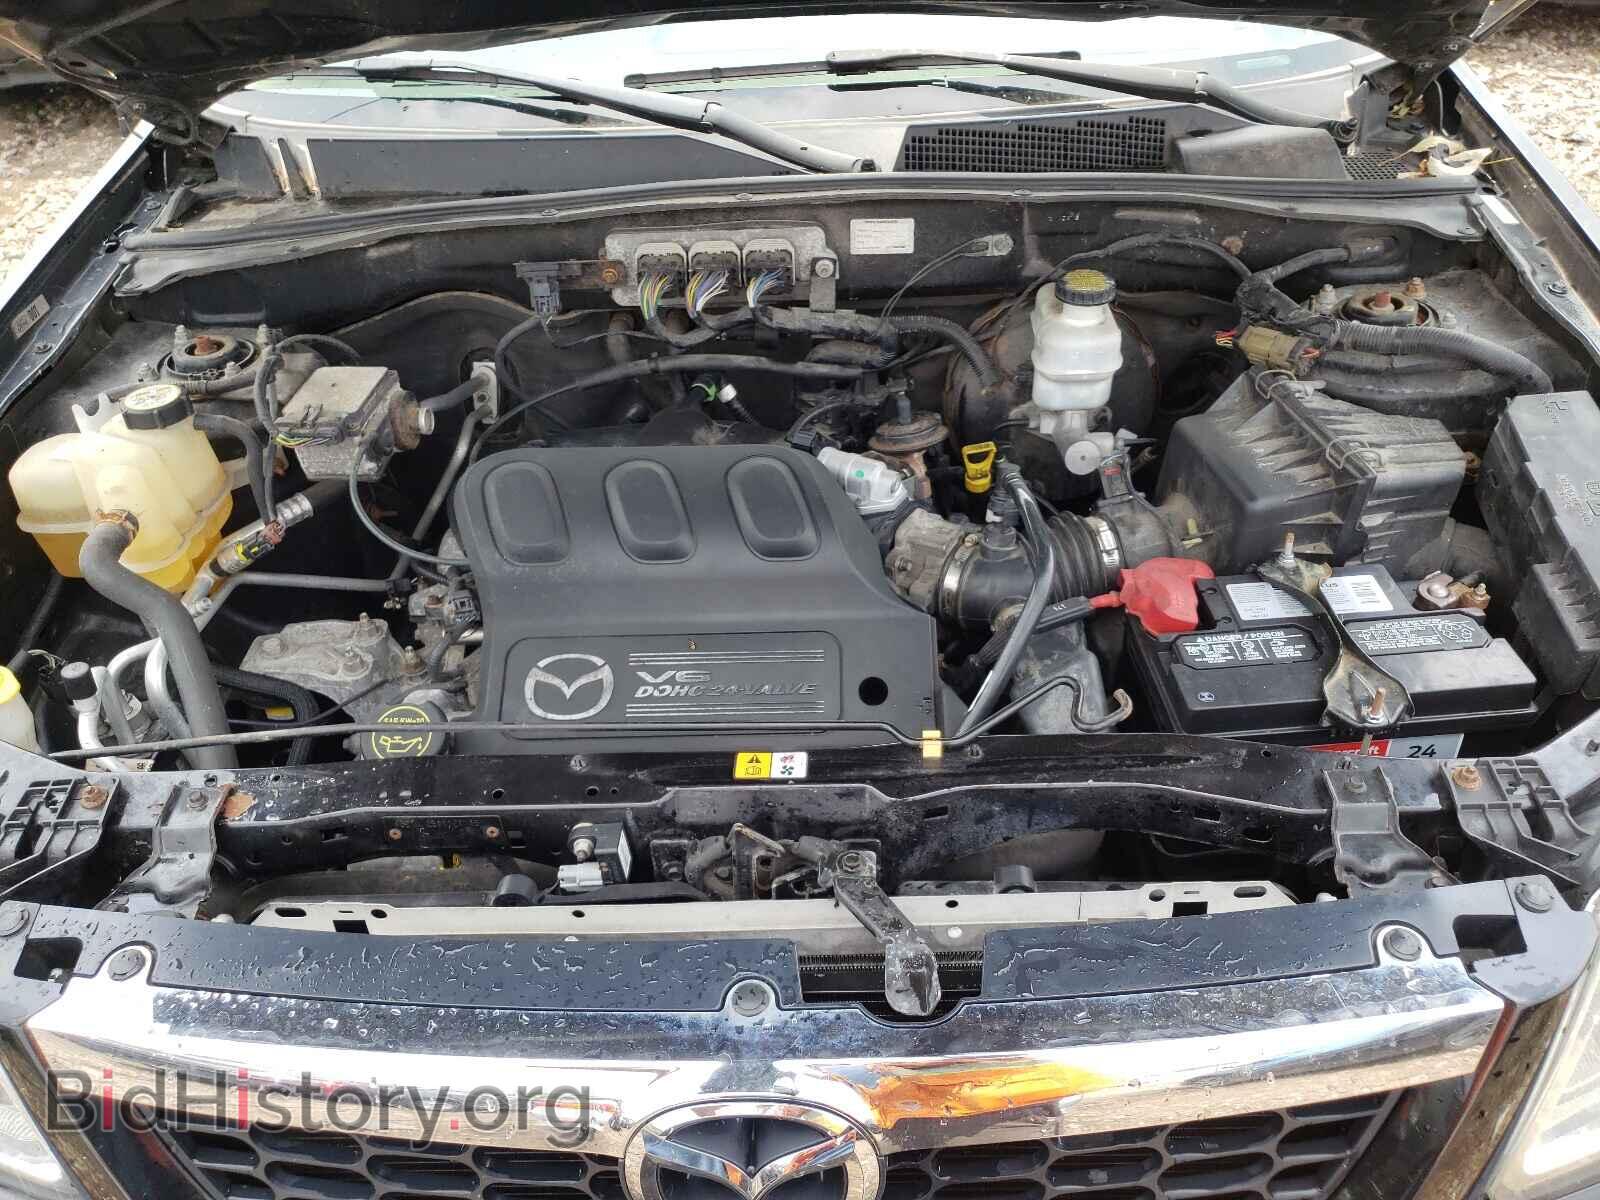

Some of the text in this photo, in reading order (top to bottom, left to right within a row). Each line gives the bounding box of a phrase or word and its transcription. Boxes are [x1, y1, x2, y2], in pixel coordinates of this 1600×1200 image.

[1204, 634, 1242, 642] DANGER
[1251, 630, 1284, 640] POISON
[636, 671, 711, 683] V6
[634, 685, 703, 697] DOHC
[1408, 744, 1437, 758] 24
